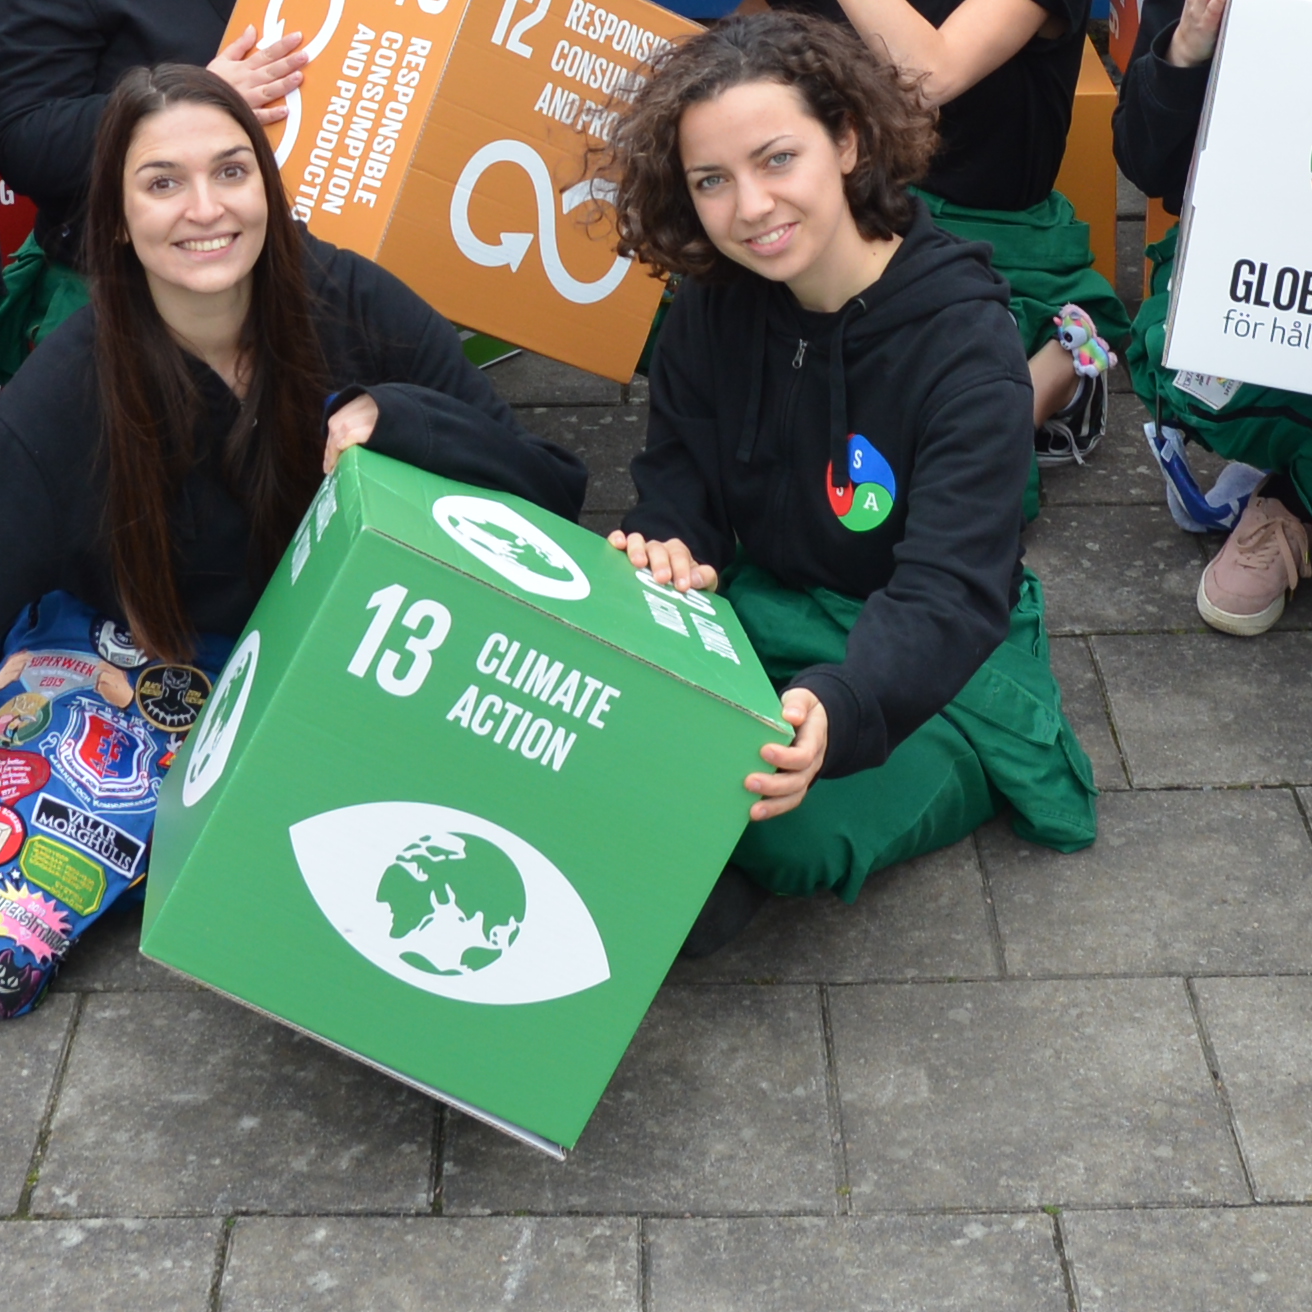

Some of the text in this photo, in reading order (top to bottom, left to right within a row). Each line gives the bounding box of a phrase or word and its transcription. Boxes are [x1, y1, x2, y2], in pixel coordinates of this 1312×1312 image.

[533, 81, 581, 126] AND
[550, 39, 648, 104] CONSUMP
[291, 22, 377, 224] AND PRODUCTIO
[321, 30, 404, 216] CONSUMPTION
[352, 36, 433, 209] RESPONSIBLE
[1222, 307, 1265, 342] för
[346, 582, 453, 699] 13
[474, 631, 622, 730] CLIMATE
[445, 684, 578, 772] ACTION
[38, 811, 133, 871] MORGHULIS
[67, 807, 117, 846] VALAR
